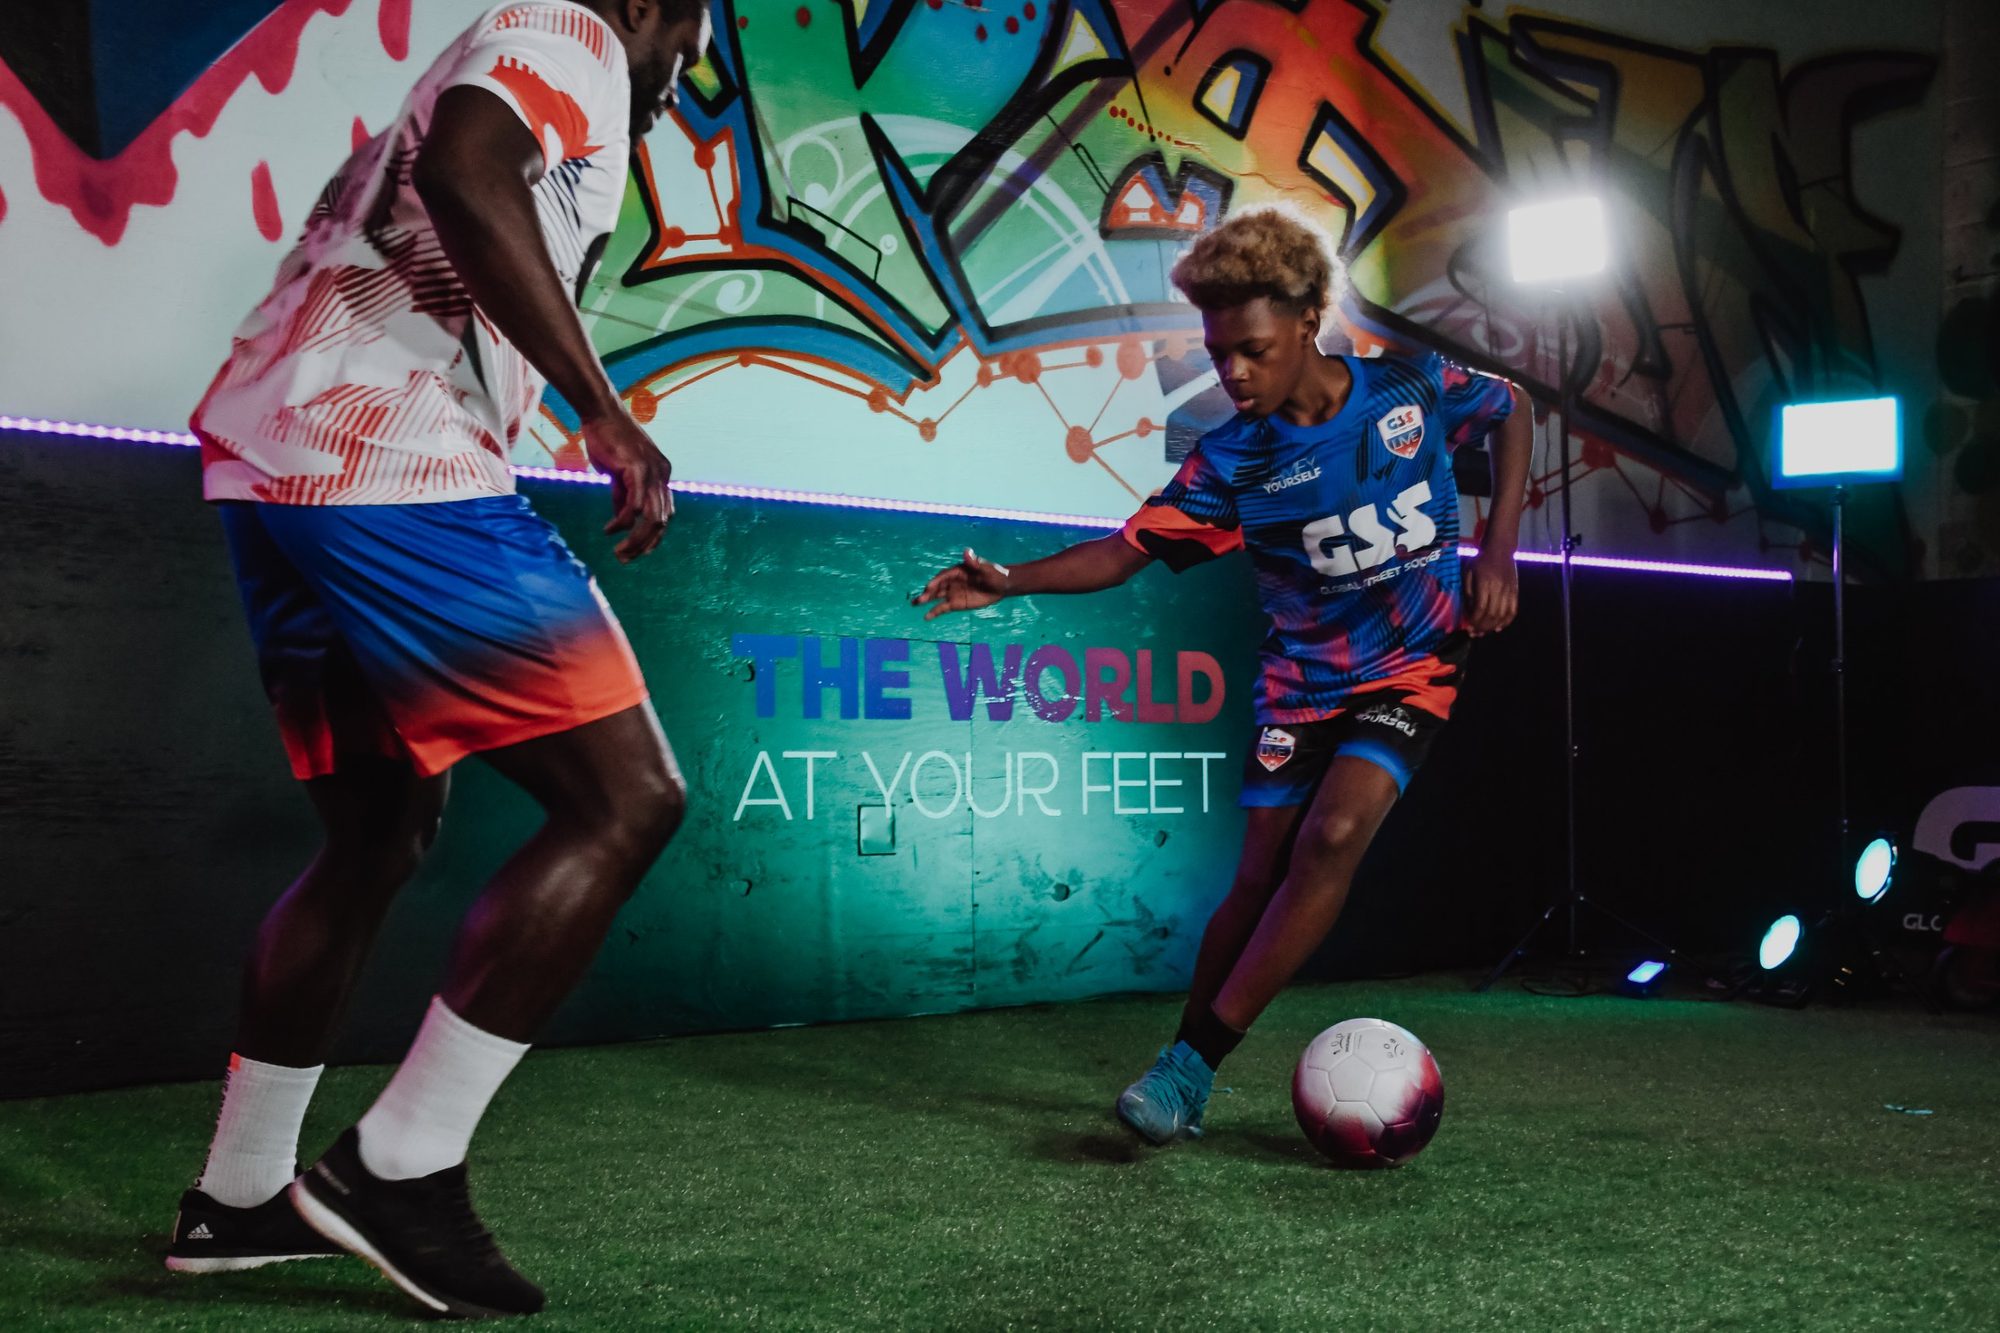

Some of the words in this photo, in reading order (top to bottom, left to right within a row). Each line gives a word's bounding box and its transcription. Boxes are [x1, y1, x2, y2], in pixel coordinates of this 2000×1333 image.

[1263, 467, 1321, 494] YOURSELF
[1302, 480, 1436, 577] GSS
[731, 633, 912, 720] THE
[936, 641, 1226, 724] WORLD
[733, 751, 838, 821] AT
[862, 751, 1062, 819] YOUR
[1082, 752, 1226, 815] FEET
